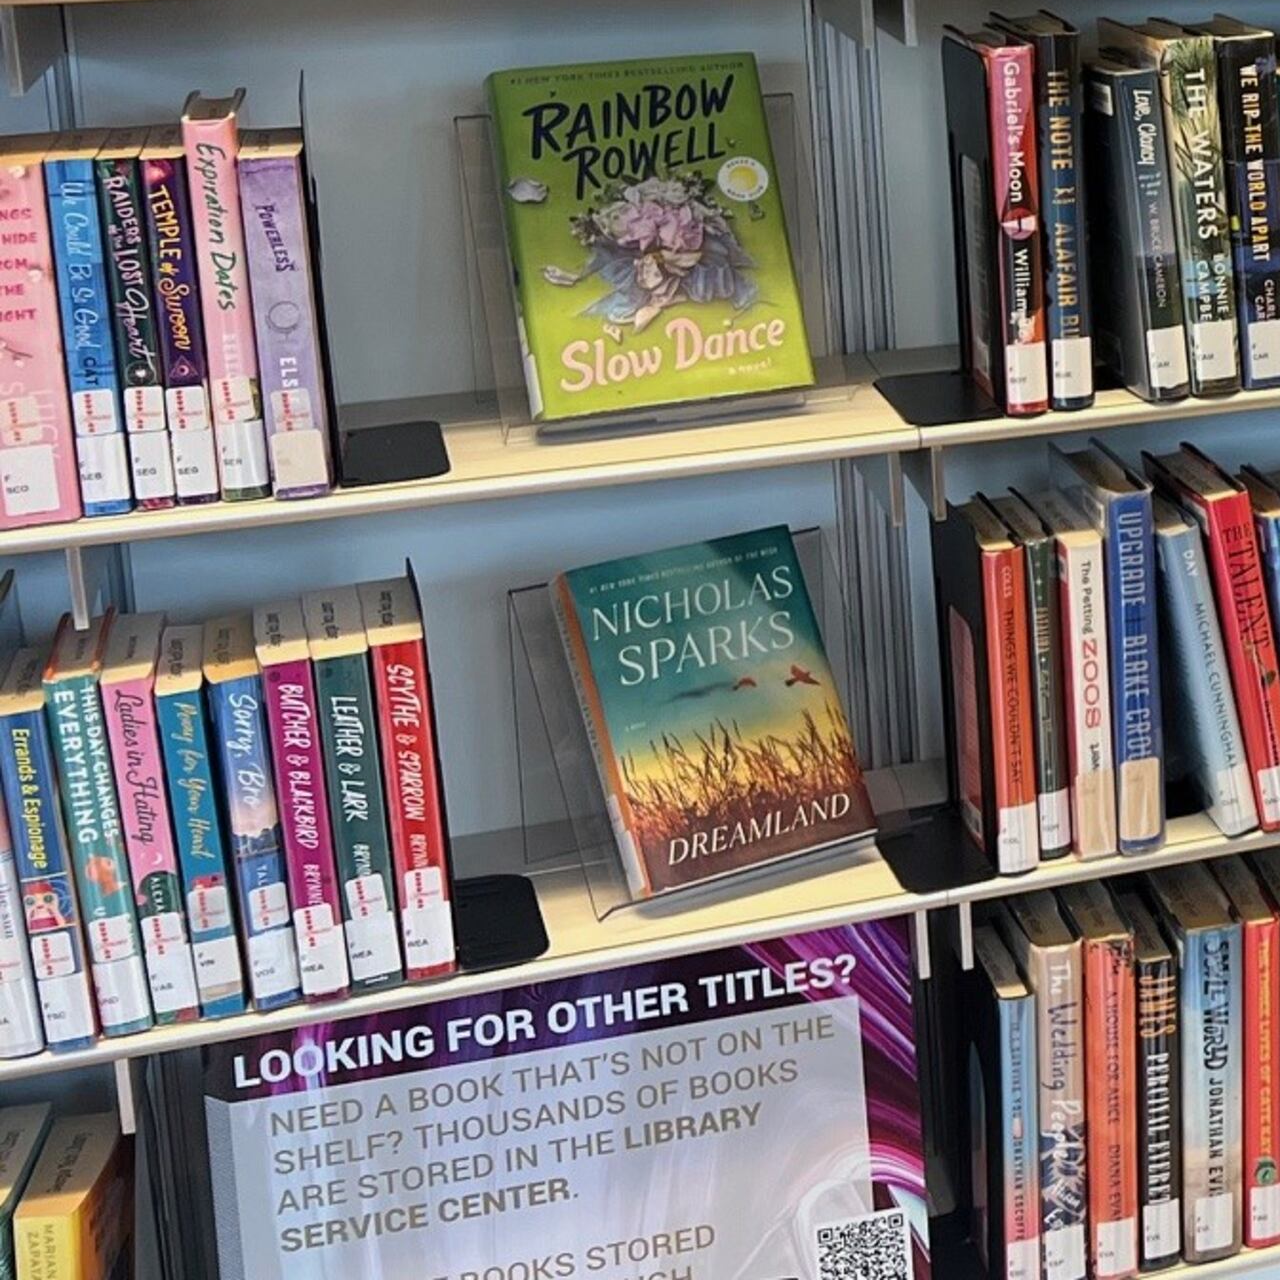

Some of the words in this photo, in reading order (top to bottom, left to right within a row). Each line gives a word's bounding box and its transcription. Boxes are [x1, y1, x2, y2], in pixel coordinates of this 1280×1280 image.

[1001, 60, 1022, 147] Gabriel's
[1183, 68, 1206, 120] THE
[1239, 64, 1258, 88] WE
[1241, 92, 1259, 119] RIP
[522, 74, 735, 160] RAINBOW
[1243, 123, 1262, 154] THE
[195, 141, 227, 245] Expiration
[562, 122, 727, 201] ROWELL
[1006, 151, 1025, 204] Moon
[1189, 128, 1220, 240] WATERS
[1246, 158, 1266, 211] WORLD
[1250, 216, 1272, 262] APART
[210, 250, 238, 312] Dates
[559, 338, 663, 393] Slow
[665, 316, 786, 371] Dance
[1079, 560, 1093, 584] The
[1116, 510, 1145, 608] UPGRADE
[591, 564, 794, 642] NICHOLAS
[1081, 586, 1095, 635] Petting
[618, 610, 795, 687] SPARKS
[1082, 638, 1100, 730] ZOOS
[53, 689, 97, 845] EVERYTHING
[402, 750, 427, 823] SPARROW
[667, 791, 851, 866] DREAMLAND
[1045, 960, 1072, 996] The
[233, 1025, 435, 1089] LOOKING
[447, 1008, 536, 1052] FOR
[547, 983, 689, 1033] OTHER
[698, 953, 856, 1009] TITLES?
[1046, 1002, 1079, 1093] Wedding
[270, 1099, 363, 1136] NEED
[375, 1093, 397, 1119] A
[408, 1073, 504, 1113] BOOK
[512, 1051, 630, 1094] THAT'S
[641, 1037, 708, 1071] NOT
[717, 1026, 762, 1056] ON
[771, 1014, 835, 1046] THE
[273, 1130, 404, 1175] SHELF?
[413, 1090, 626, 1150] THOUSANDS
[636, 1080, 680, 1109] OF
[690, 1059, 799, 1100] BOOKS
[1043, 1097, 1087, 1161] People
[277, 1179, 348, 1216] ARE
[358, 1153, 494, 1200] STORED
[506, 1144, 539, 1172] IN
[548, 1129, 615, 1163] THE
[623, 1101, 762, 1150] LIBRARY
[280, 1203, 429, 1253] SERVICE
[437, 1177, 579, 1222] CENTER.
[586, 1225, 715, 1269] STORED
